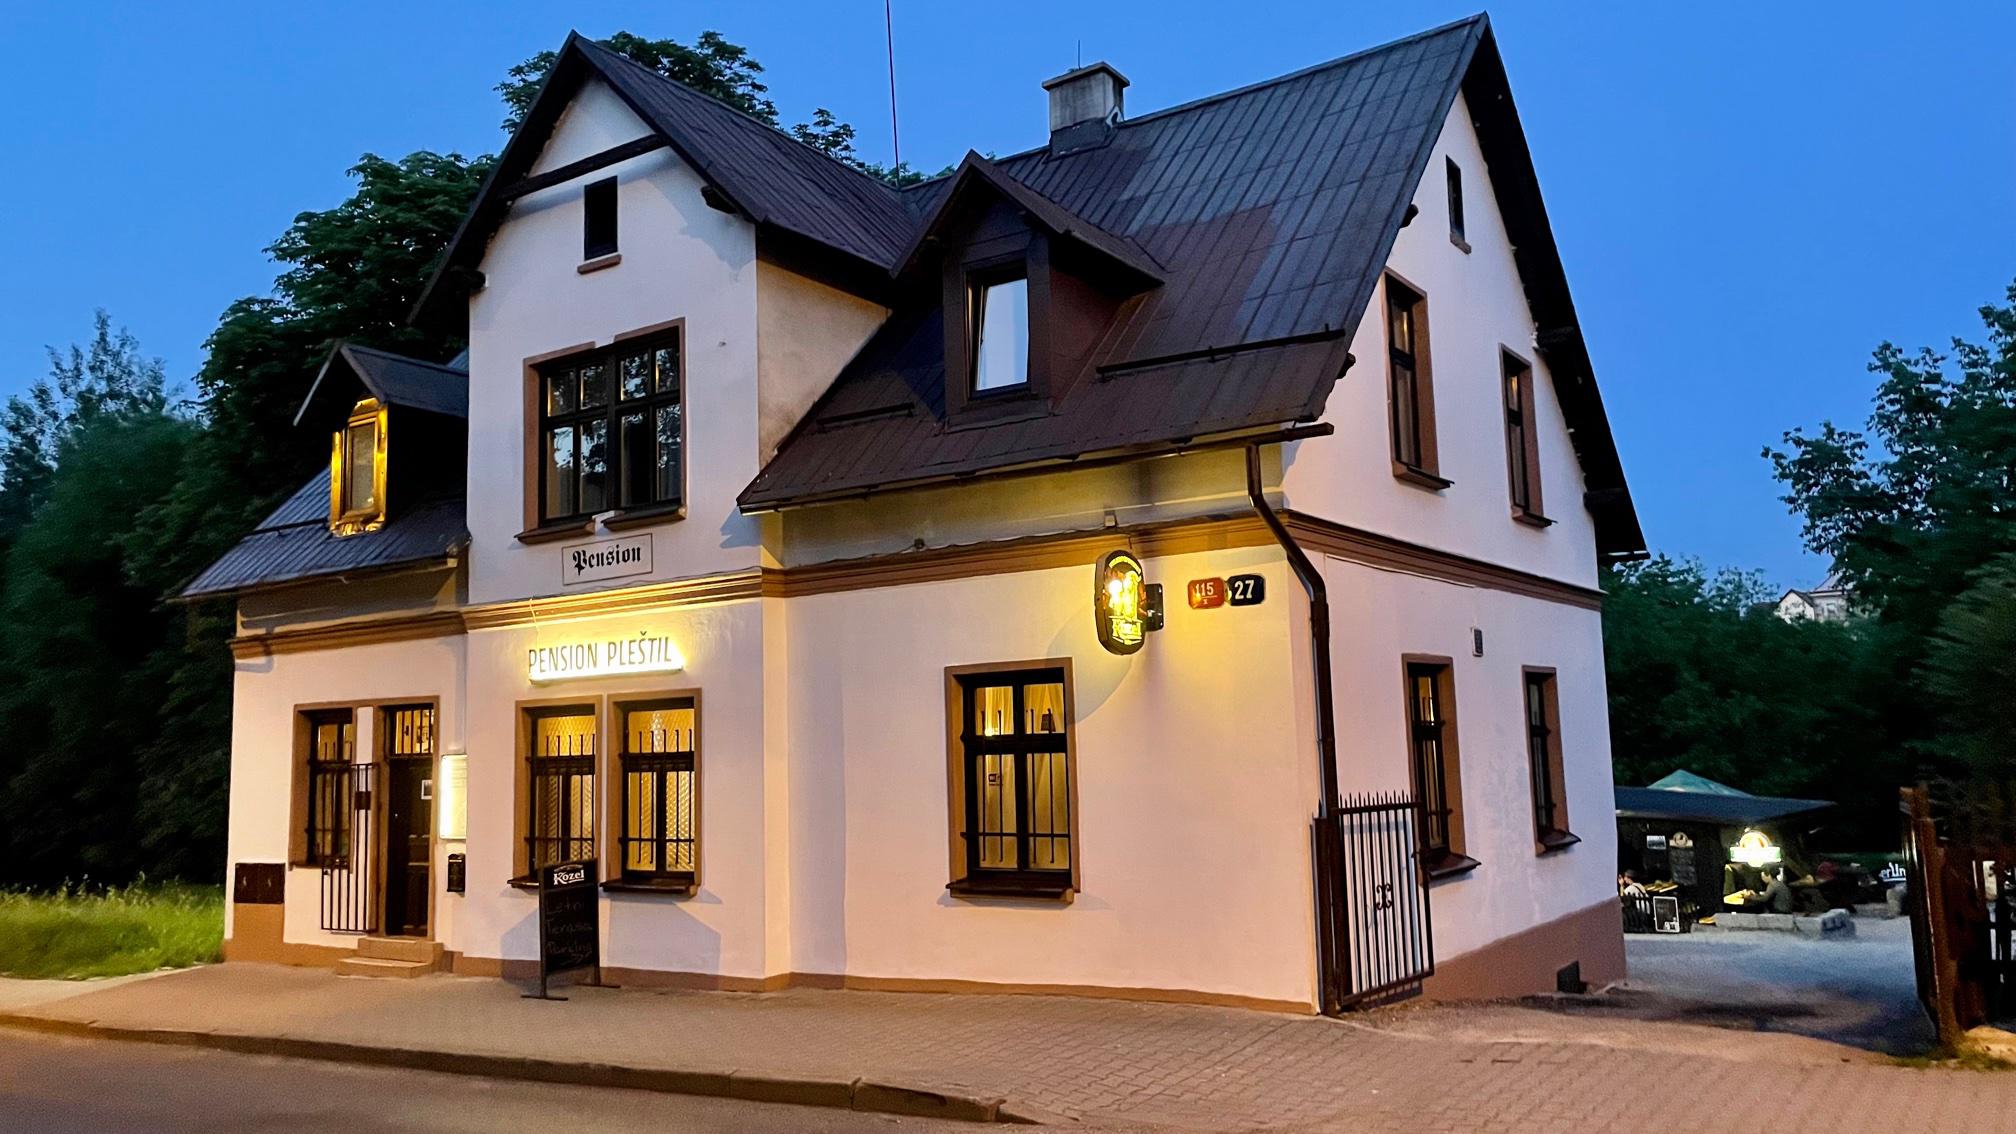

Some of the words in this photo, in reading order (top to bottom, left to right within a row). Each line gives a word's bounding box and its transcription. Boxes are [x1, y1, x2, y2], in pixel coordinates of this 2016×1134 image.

[572, 544, 641, 576] Pension
[1195, 582, 1214, 596] 115
[1234, 580, 1254, 599] 27
[528, 643, 598, 673] PENSION
[607, 631, 672, 667] PLEŠTIL
[553, 869, 585, 885] Kozel
